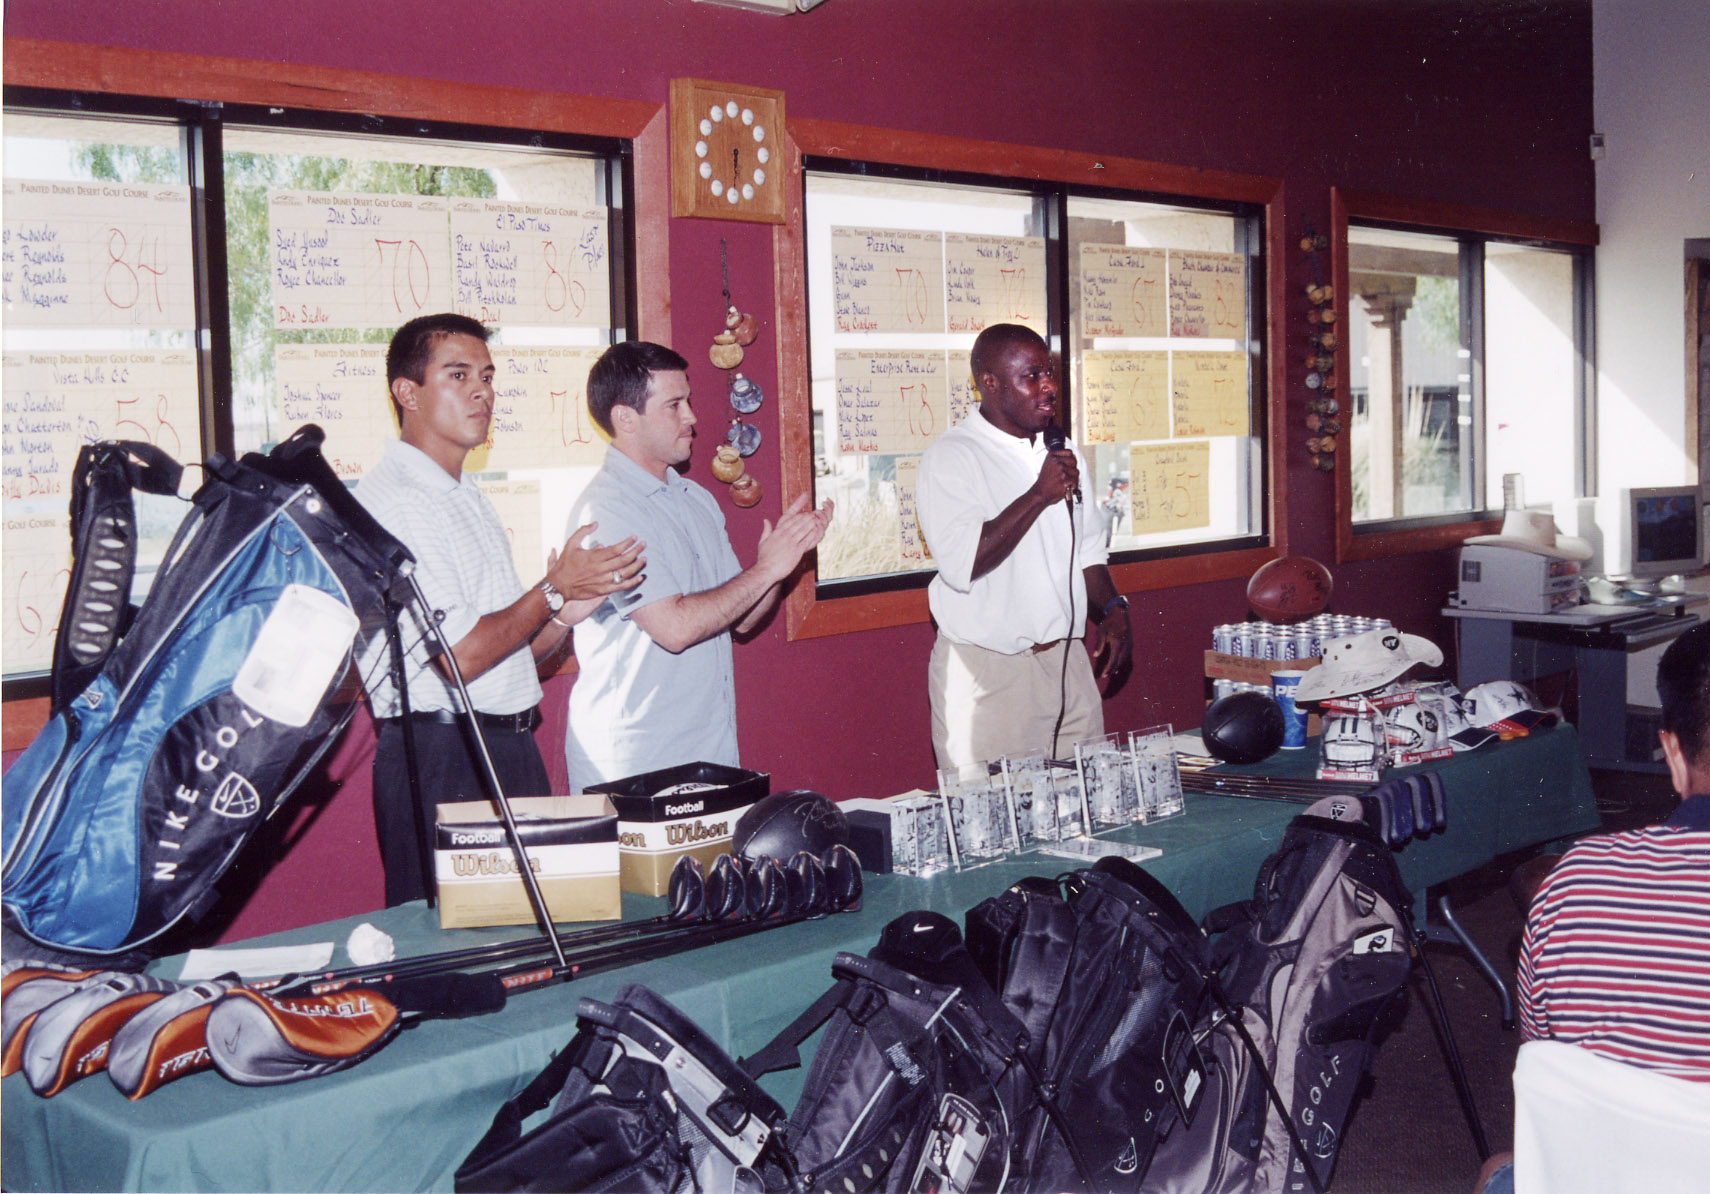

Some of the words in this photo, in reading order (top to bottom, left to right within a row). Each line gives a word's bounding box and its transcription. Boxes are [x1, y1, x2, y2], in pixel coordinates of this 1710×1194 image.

[21, 183, 50, 194] PAINTED
[52, 184, 75, 195] DUNES
[77, 185, 100, 196] DESERT
[103, 186, 120, 197] GOLF
[123, 187, 149, 199] COURSE
[307, 195, 331, 205] PAINTED
[333, 196, 350, 206] DUNES
[353, 197, 372, 207] DESERT
[375, 198, 389, 208] GOLF
[392, 199, 413, 208] COURSE
[484, 203, 506, 213] PAINTED
[507, 204, 524, 214] DUNES
[525, 206, 542, 215] DESERT
[544, 206, 558, 216] GOLF
[559, 207, 577, 217] COURSE
[104, 228, 168, 313] 84
[375, 239, 429, 313] 70
[542, 240, 586, 319] 86
[896, 268, 928, 325] 70
[1000, 268, 1029, 320] 72
[1131, 277, 1155, 328] 67
[29, 354, 57, 364] PAINTED
[61, 354, 82, 364] DUNES
[84, 354, 107, 364] DESERT
[110, 354, 128, 364] GOLF
[130, 354, 155, 364] COURSE
[550, 390, 593, 448] 71
[900, 383, 934, 436] 78
[196, 709, 264, 772] GOL
[153, 784, 200, 880] NIKE
[665, 800, 704, 816] Football
[665, 820, 728, 846] Wilson
[452, 832, 501, 845] Football
[1302, 1055, 1341, 1125] GOLF
